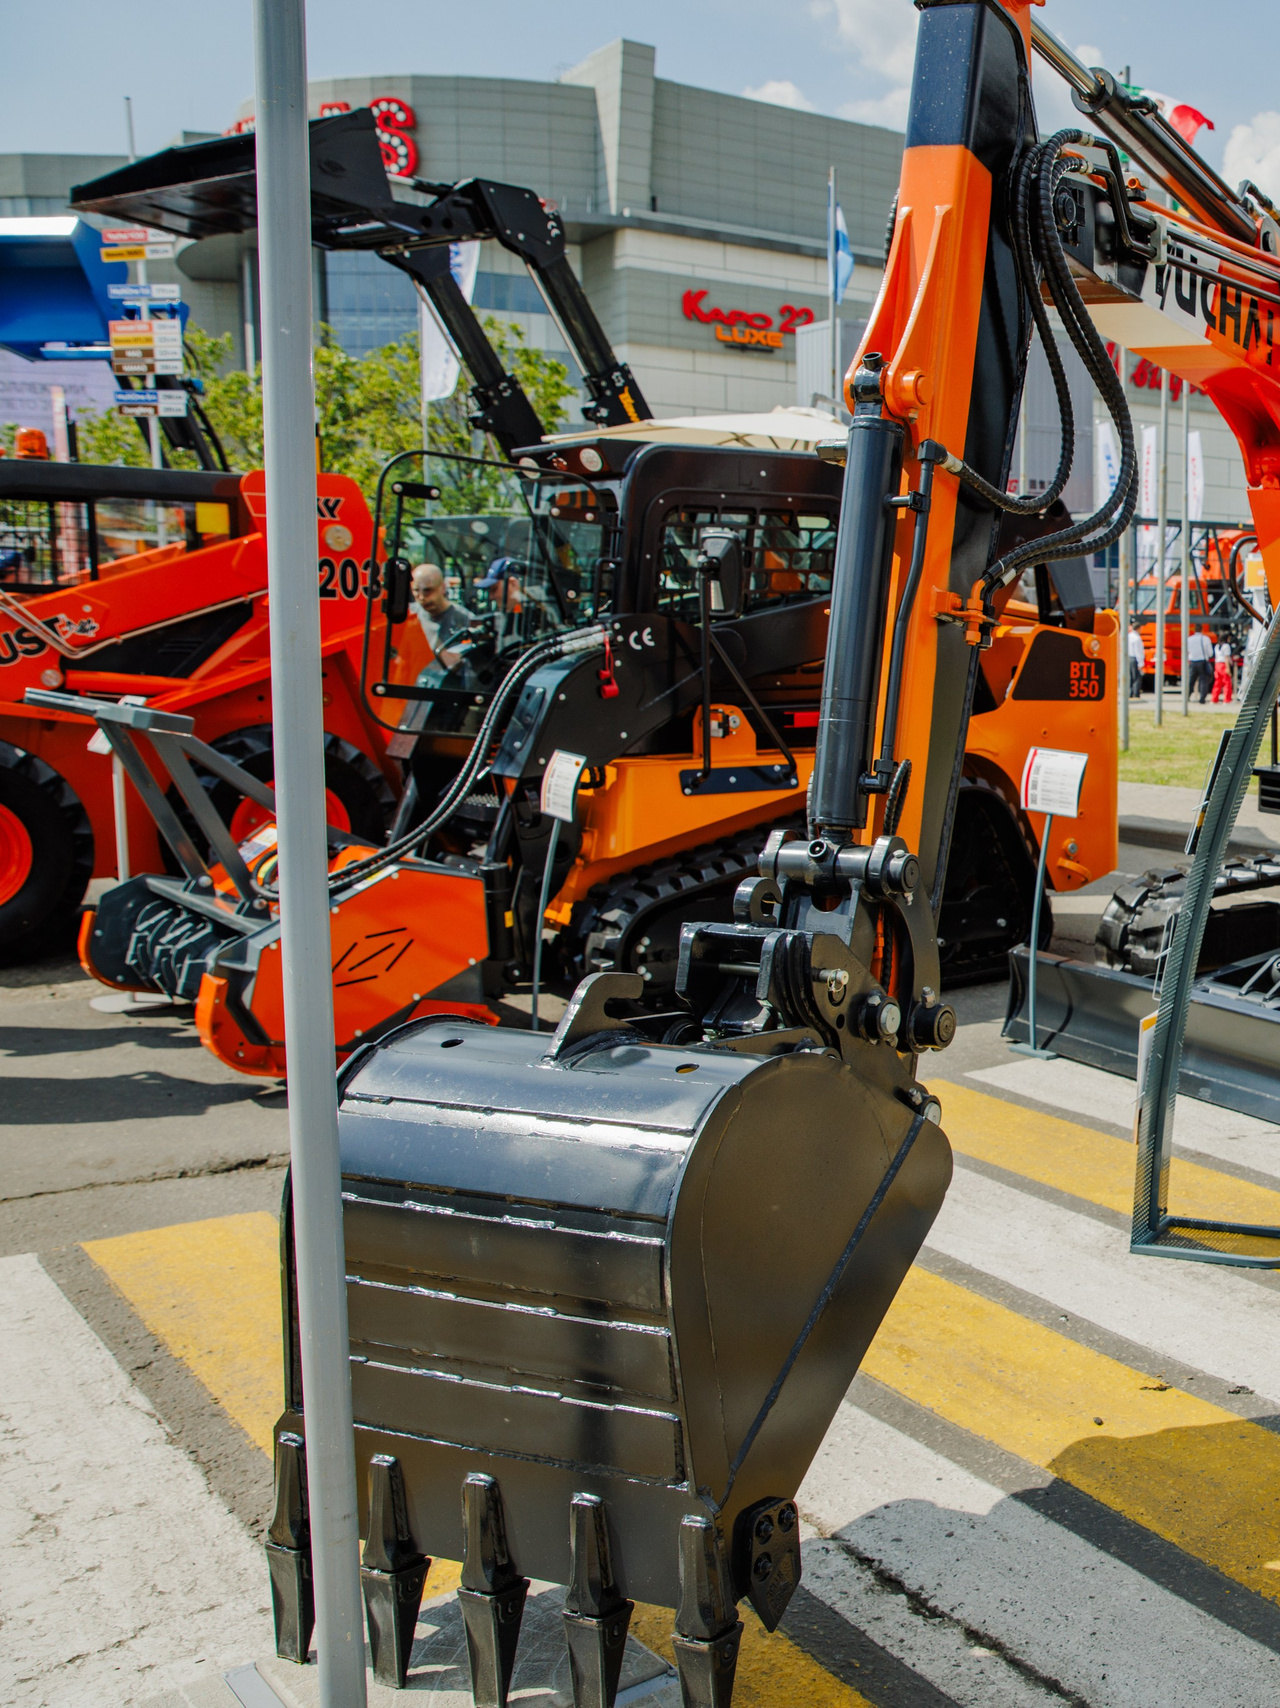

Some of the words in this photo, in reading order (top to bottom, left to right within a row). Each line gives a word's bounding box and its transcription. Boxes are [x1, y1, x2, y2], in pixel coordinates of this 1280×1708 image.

[715, 325, 785, 349] LUXE
[1070, 662, 1099, 680] BTL
[1069, 680, 1099, 698] 350
